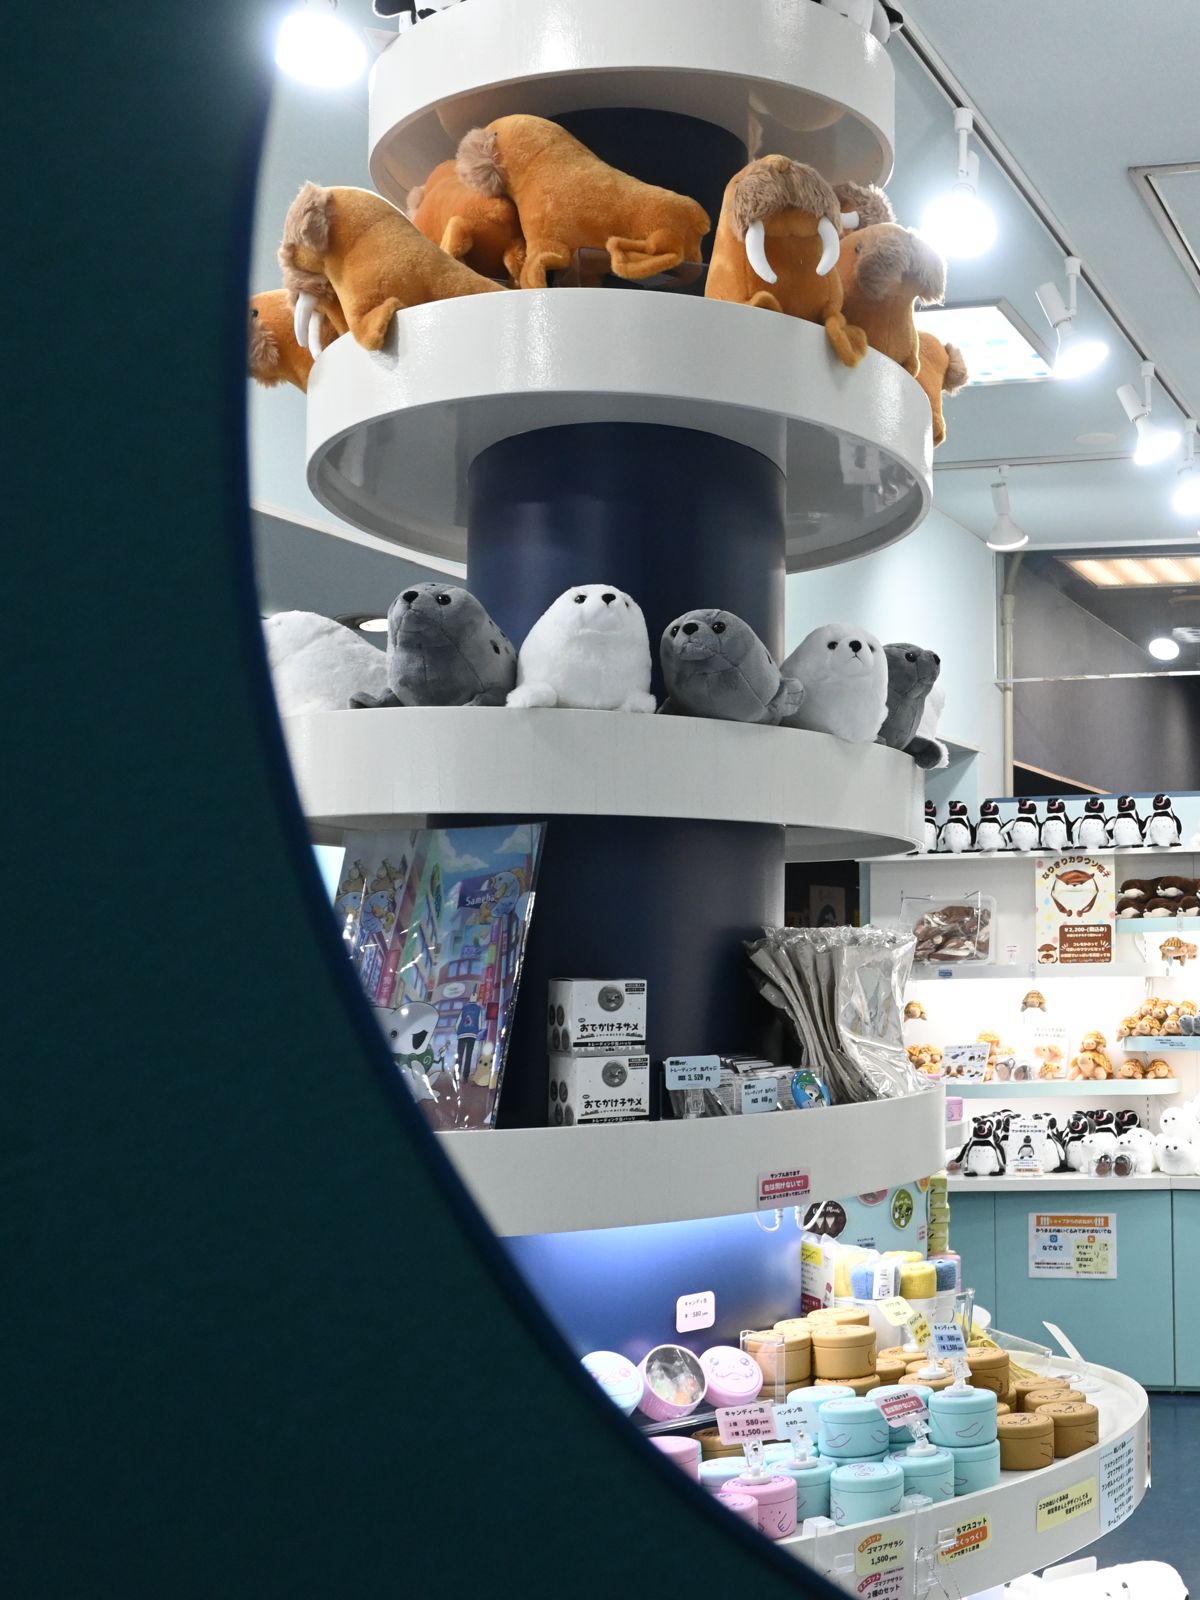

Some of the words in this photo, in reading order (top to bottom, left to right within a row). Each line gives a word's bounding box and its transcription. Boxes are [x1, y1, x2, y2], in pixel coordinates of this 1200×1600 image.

[579, 1022, 639, 1033] おでかけ子ザメ
[584, 1097, 643, 1109] おでかけ子ザメ
[745, 1418, 759, 1426] 580
[741, 1428, 761, 1437] 1,500
[866, 1539, 904, 1554] ゴマフアザラシ
[871, 1554, 889, 1566] 1,500
